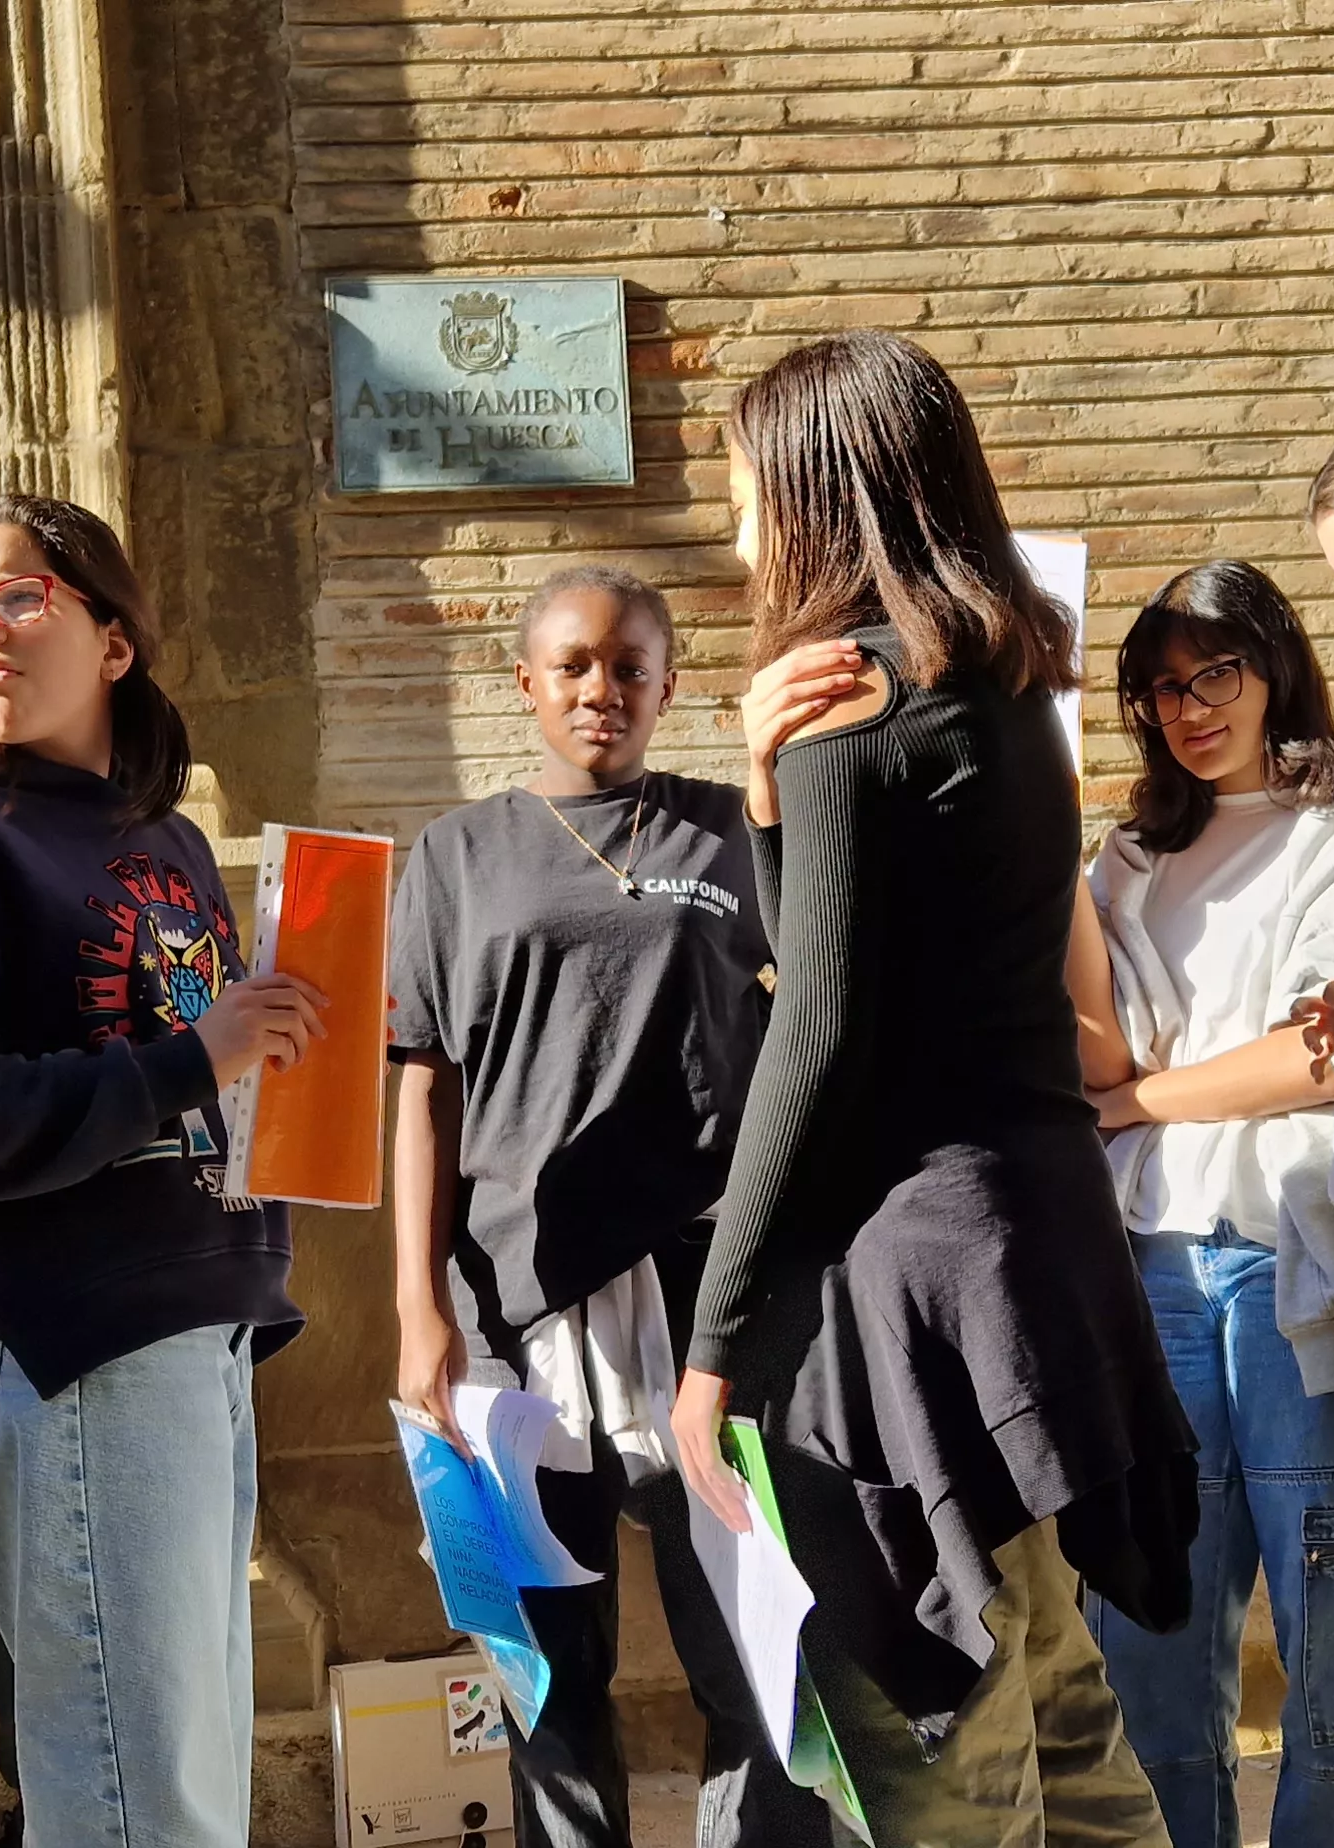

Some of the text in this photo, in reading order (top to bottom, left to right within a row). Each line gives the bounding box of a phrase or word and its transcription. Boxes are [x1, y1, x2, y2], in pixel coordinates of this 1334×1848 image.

[350, 379, 619, 419] AYUNTAMIENTO
[387, 423, 581, 470] DE HUESCA
[644, 879, 740, 915] CALIFORNIA
[673, 895, 725, 918] LOS ANGELES
[433, 1494, 455, 1511] LOS
[443, 1530, 458, 1544] EL
